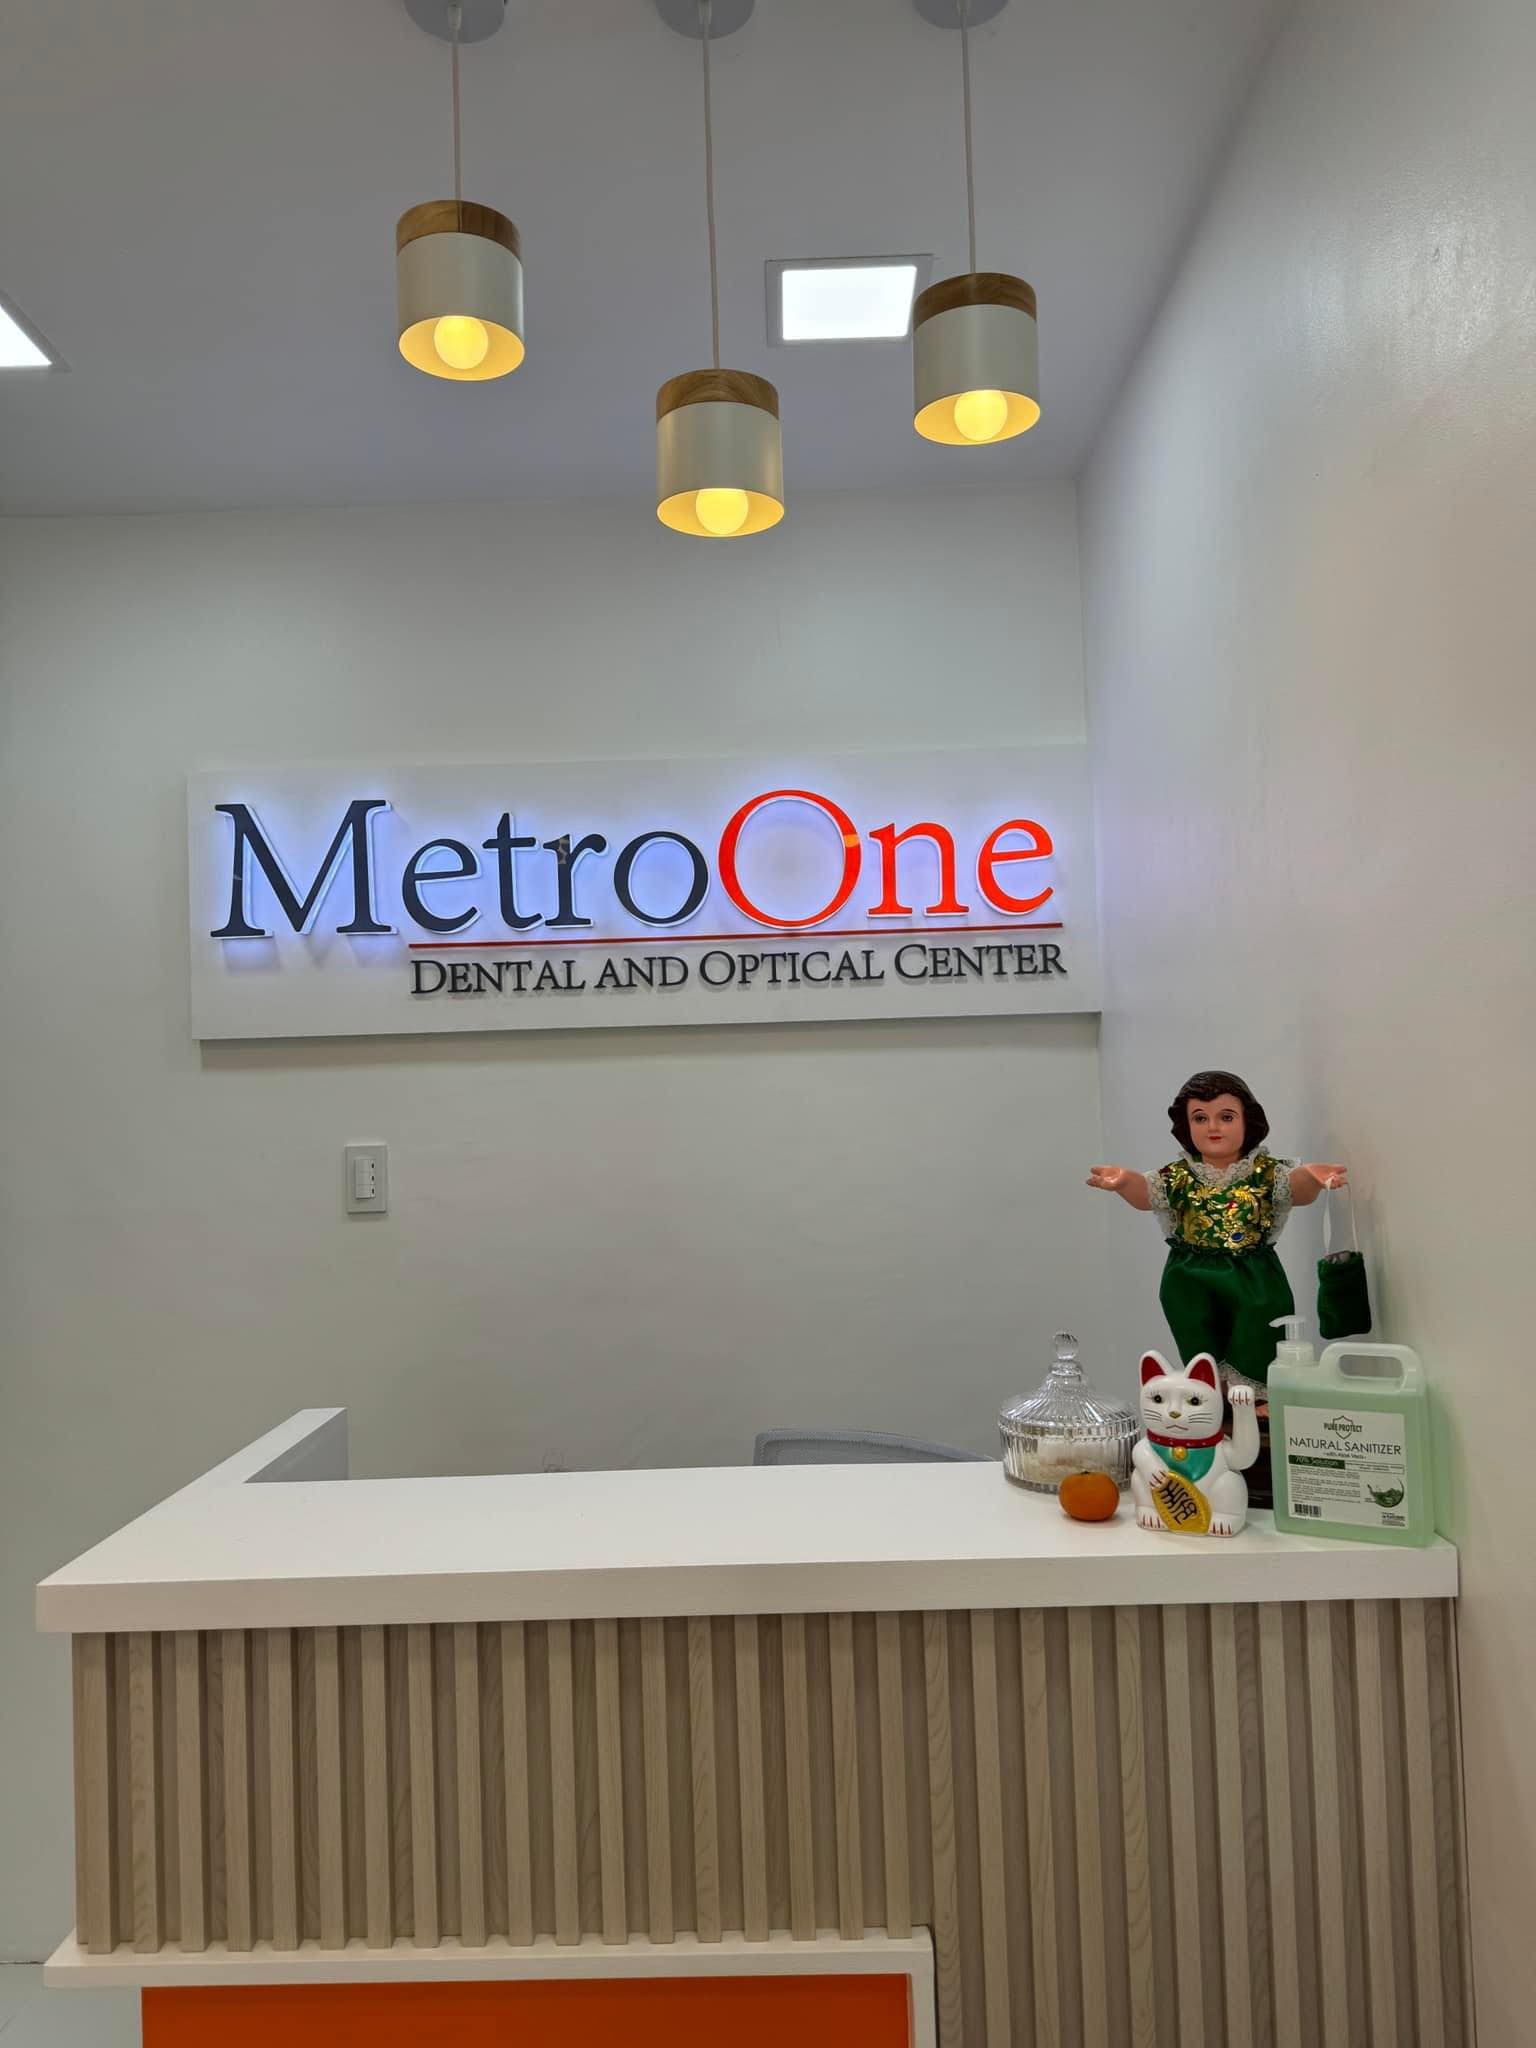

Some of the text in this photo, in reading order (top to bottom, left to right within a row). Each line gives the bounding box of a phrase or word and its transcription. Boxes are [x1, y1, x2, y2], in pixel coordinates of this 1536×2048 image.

[210, 789, 1055, 937] MetroOne
[410, 943, 1067, 994] DENTAL AND OPTICAL CENTER
[1323, 1423, 1362, 1433] PURE PROTECT
[1289, 1437, 1402, 1455] NATURAL SANITIZER
